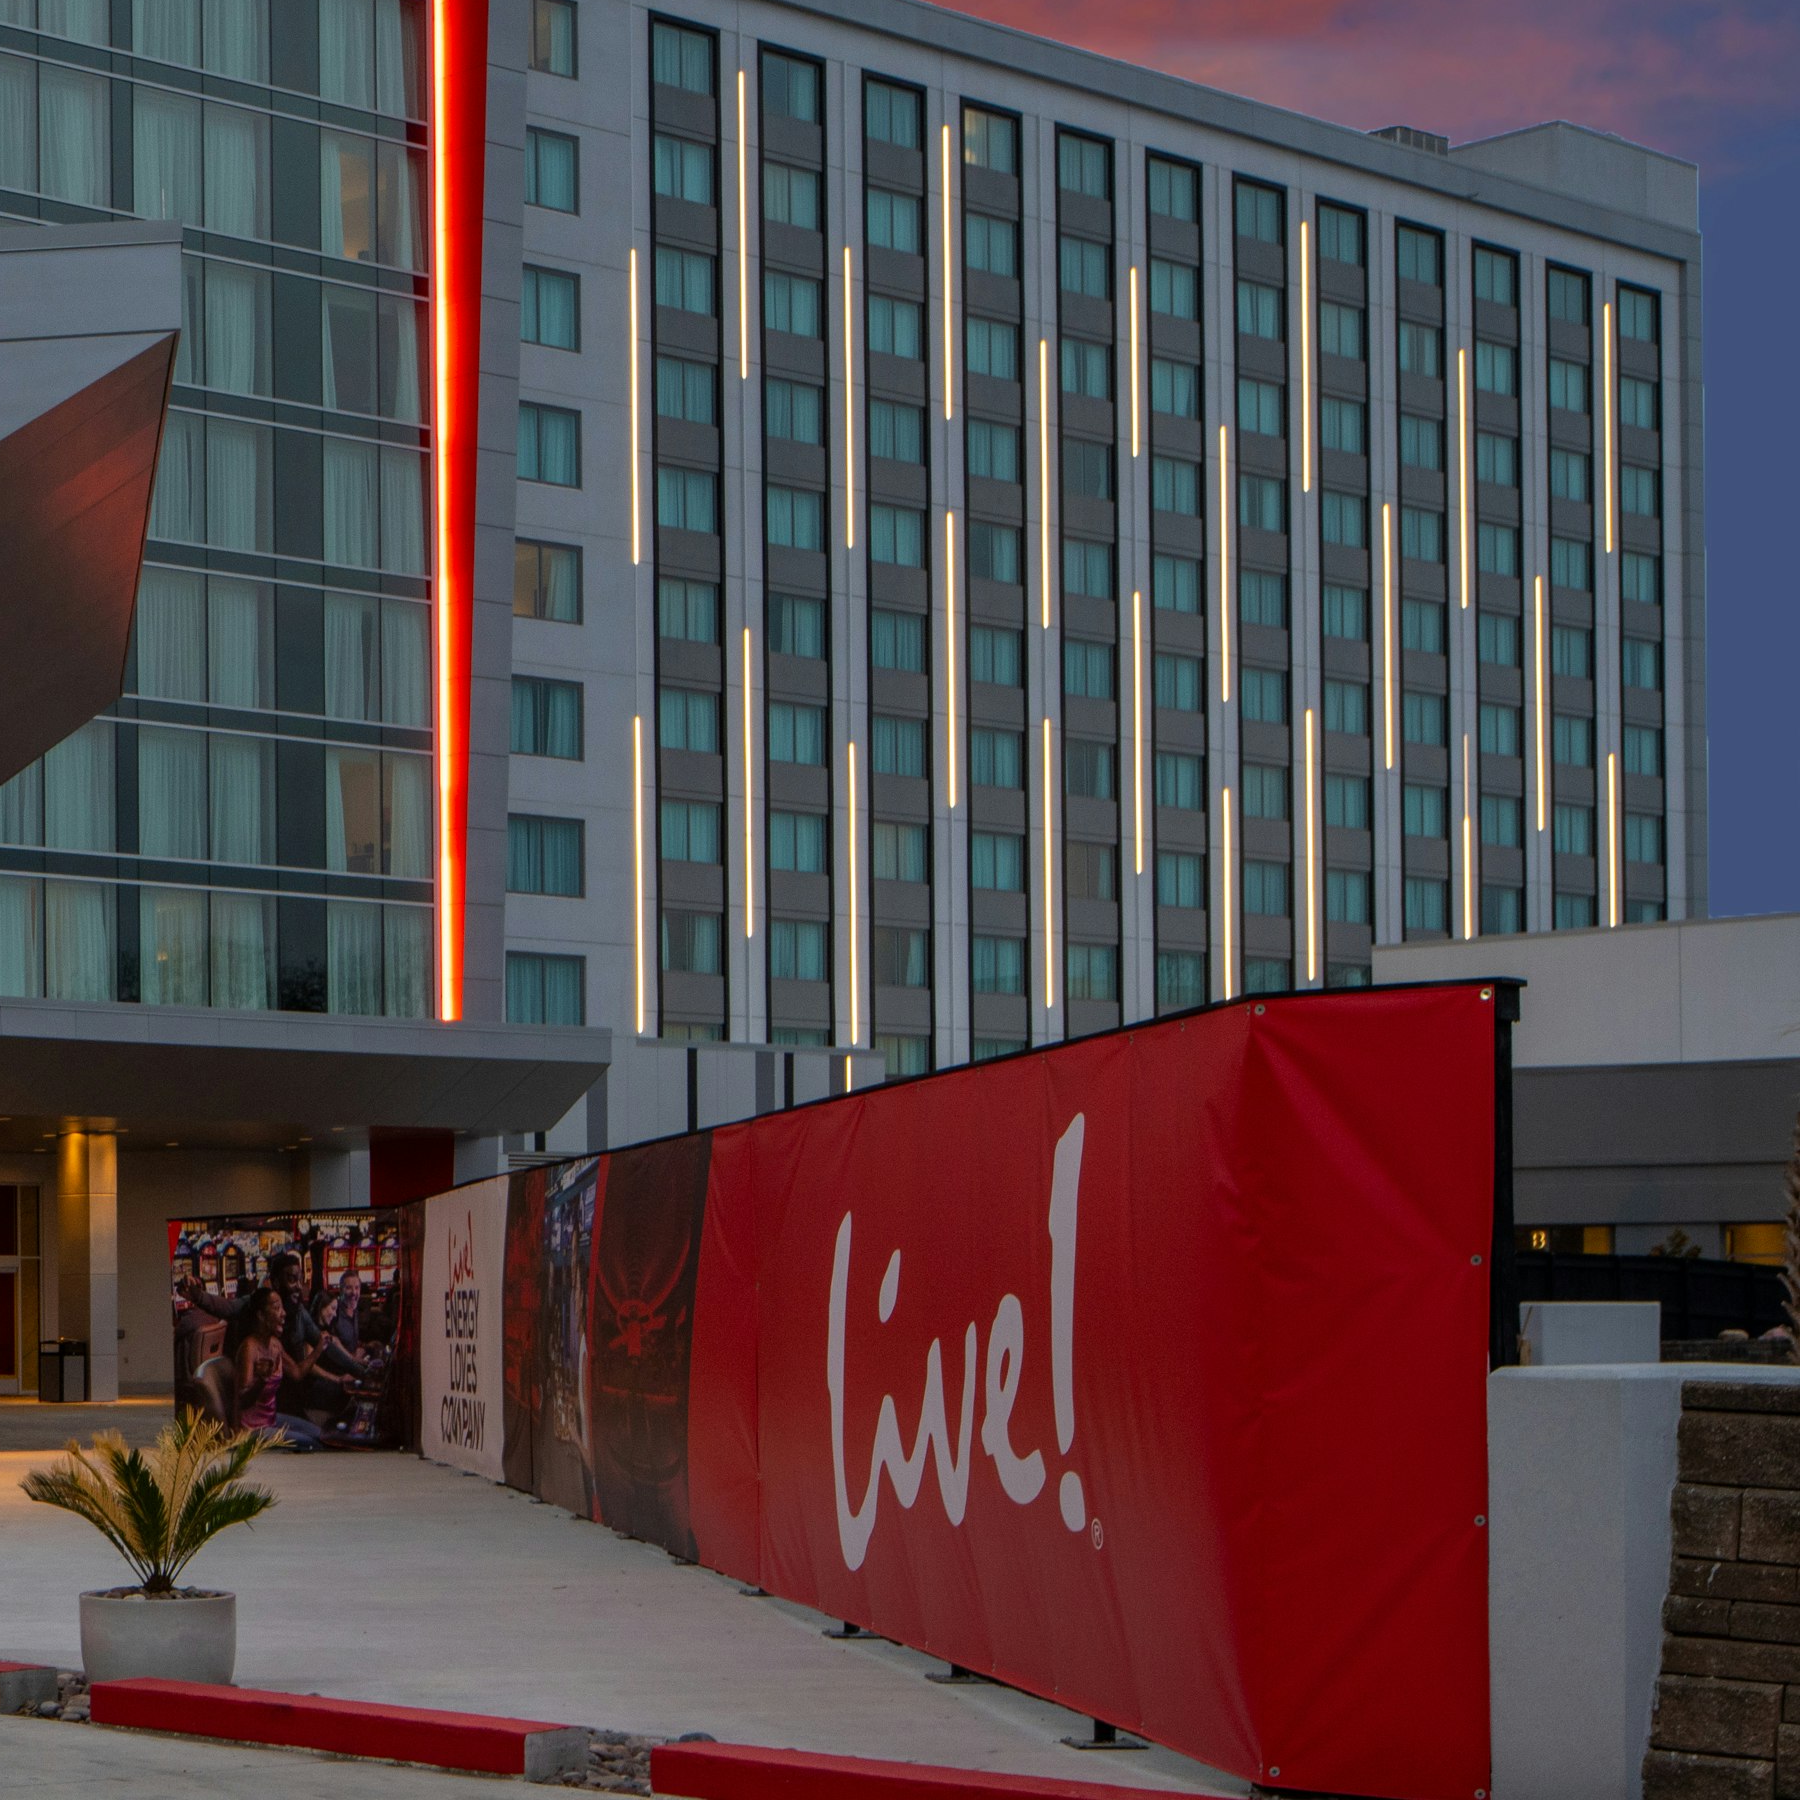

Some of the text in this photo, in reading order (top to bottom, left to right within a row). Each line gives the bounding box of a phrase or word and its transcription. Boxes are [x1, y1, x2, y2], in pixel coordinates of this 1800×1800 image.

[444, 1289, 480, 1340] ENERGY
[449, 1343, 478, 1394] LOVES
[441, 1395, 486, 1452] COMPANY
